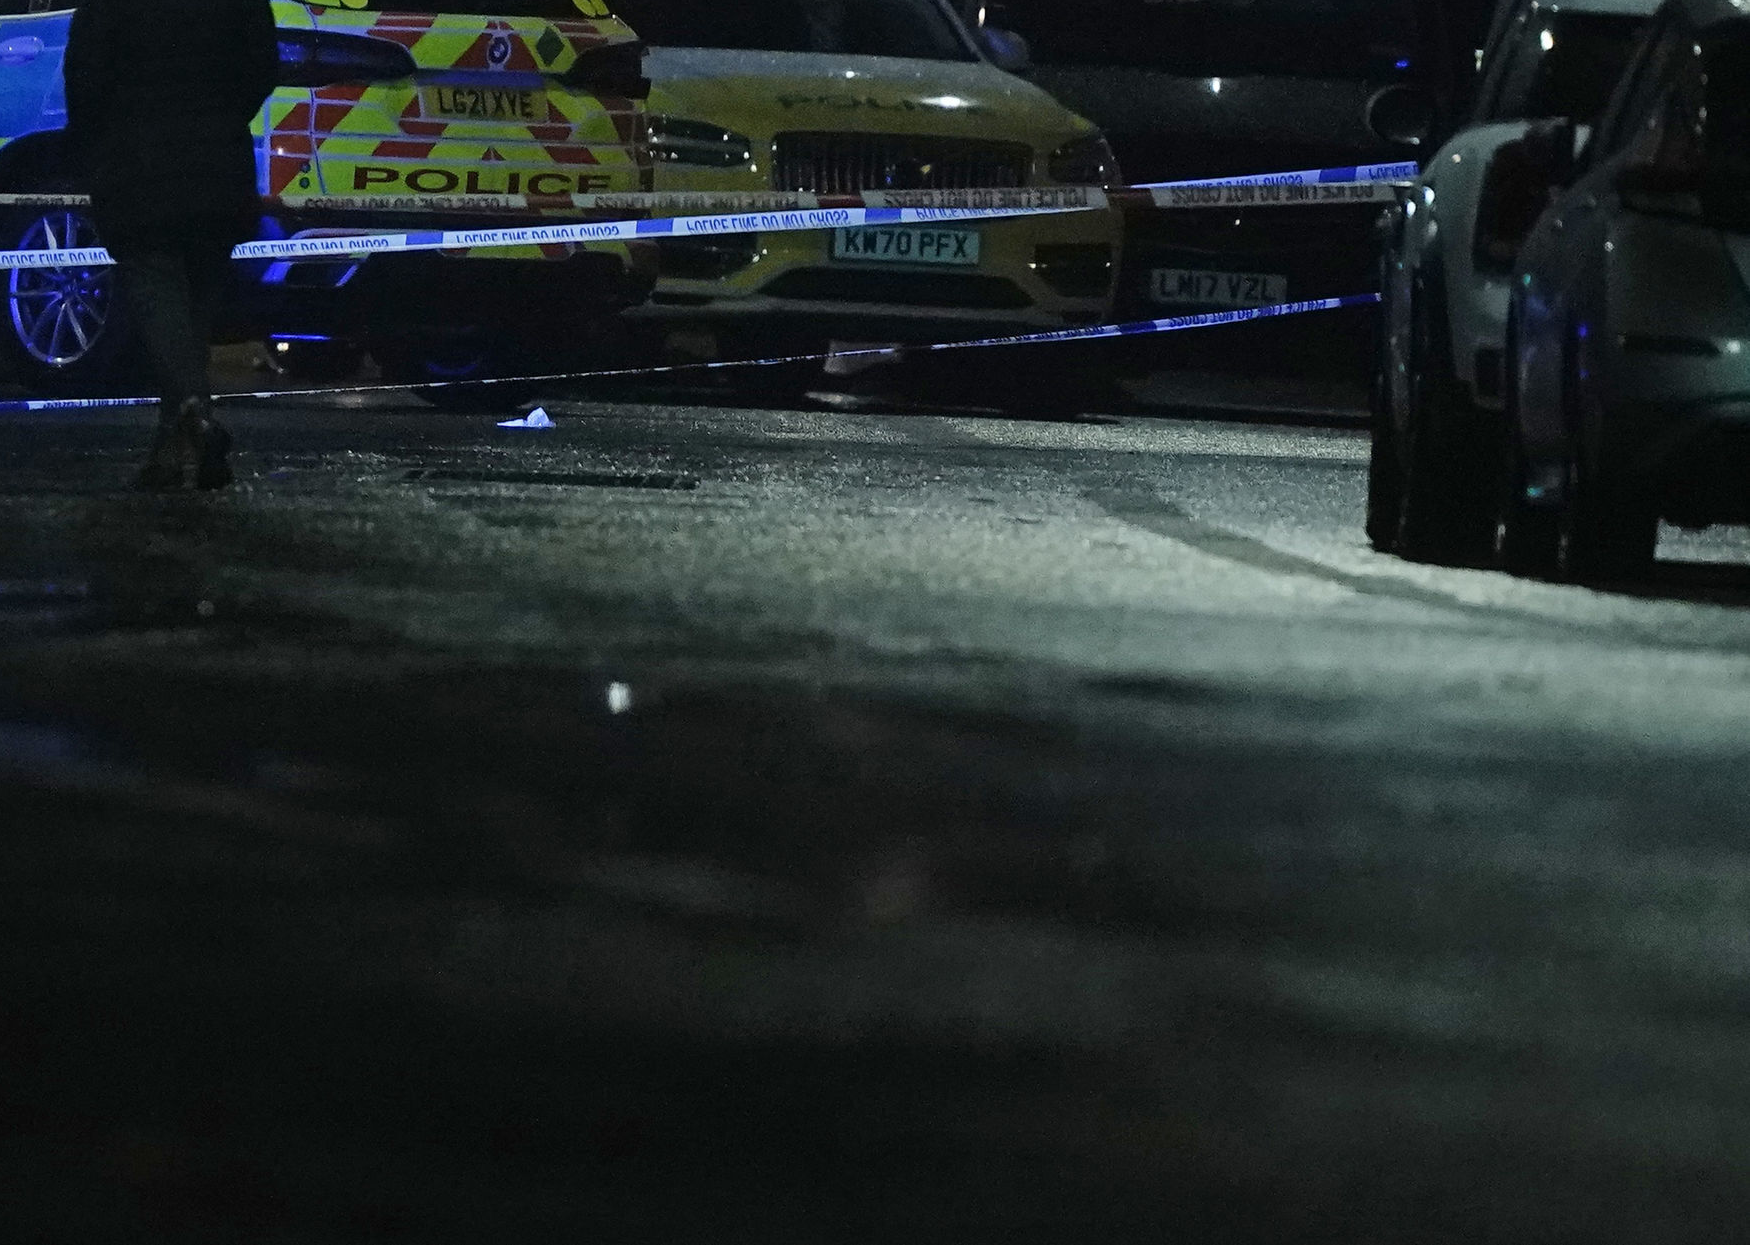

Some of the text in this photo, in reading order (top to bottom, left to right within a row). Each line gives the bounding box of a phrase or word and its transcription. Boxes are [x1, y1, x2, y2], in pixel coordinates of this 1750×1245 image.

[352, 166, 611, 195] POLICE
[844, 230, 968, 258] KW70 PFX
